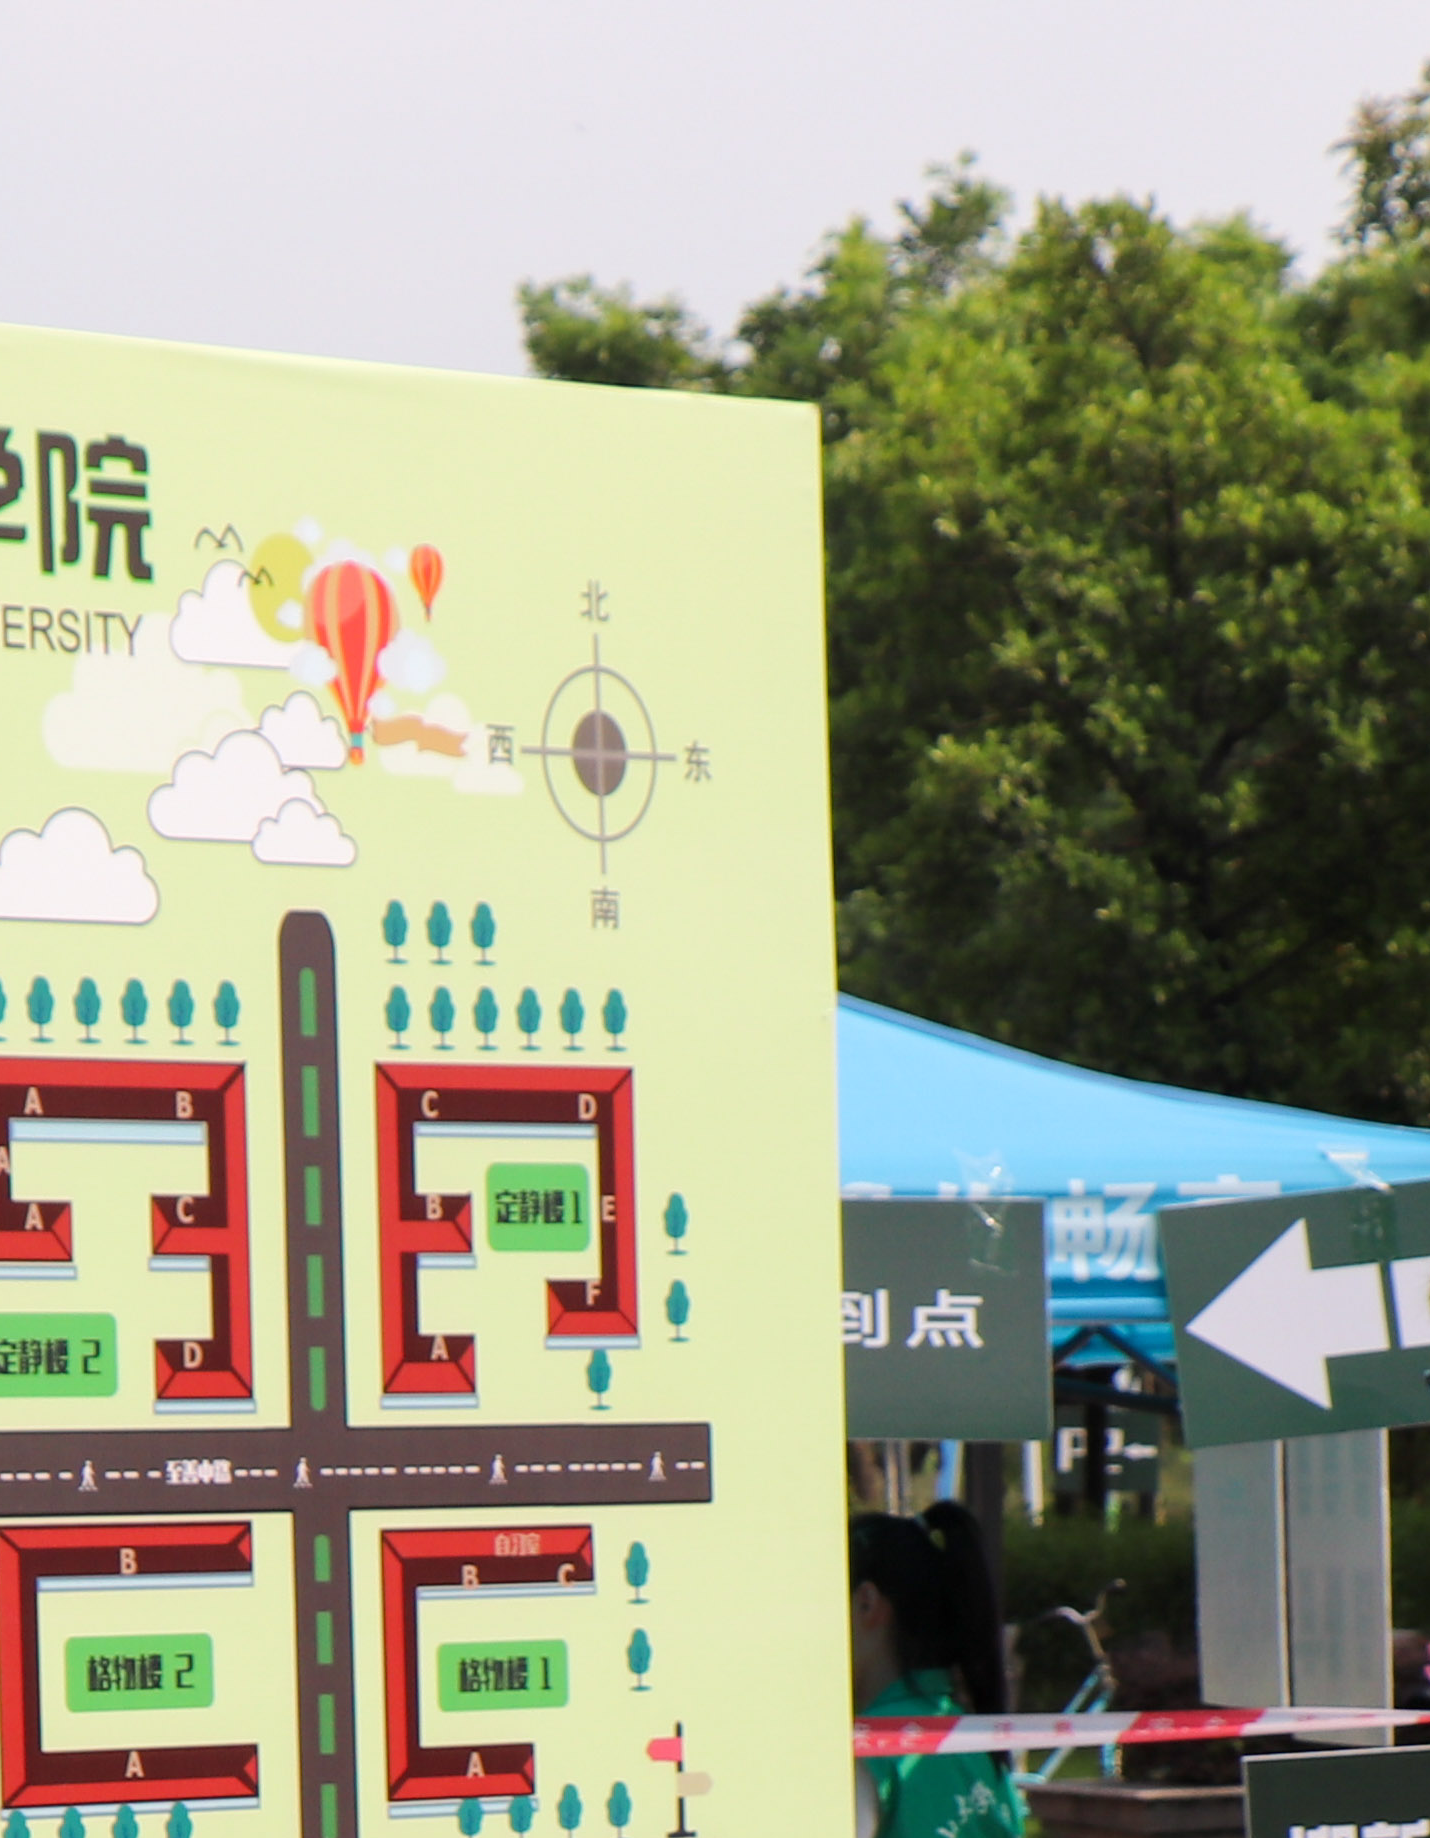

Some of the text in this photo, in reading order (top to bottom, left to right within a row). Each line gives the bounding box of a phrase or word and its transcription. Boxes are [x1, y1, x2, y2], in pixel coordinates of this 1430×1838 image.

[582, 580, 608, 622] 北
[487, 725, 514, 764] 西
[685, 741, 711, 782] 东
[590, 888, 618, 929] 南
[23, 1087, 193, 1120] A B
[421, 1091, 597, 1119] C D
[24, 1203, 45, 1231] A
[176, 1196, 194, 1224] C
[426, 1194, 443, 1221] B
[602, 1195, 615, 1223] E
[587, 1280, 601, 1306] F
[183, 1342, 204, 1369] D
[430, 1335, 449, 1361] A
[120, 1548, 137, 1573] B
[462, 1564, 574, 1589] B C
[125, 1752, 143, 1777] A
[467, 1753, 483, 1777] A
